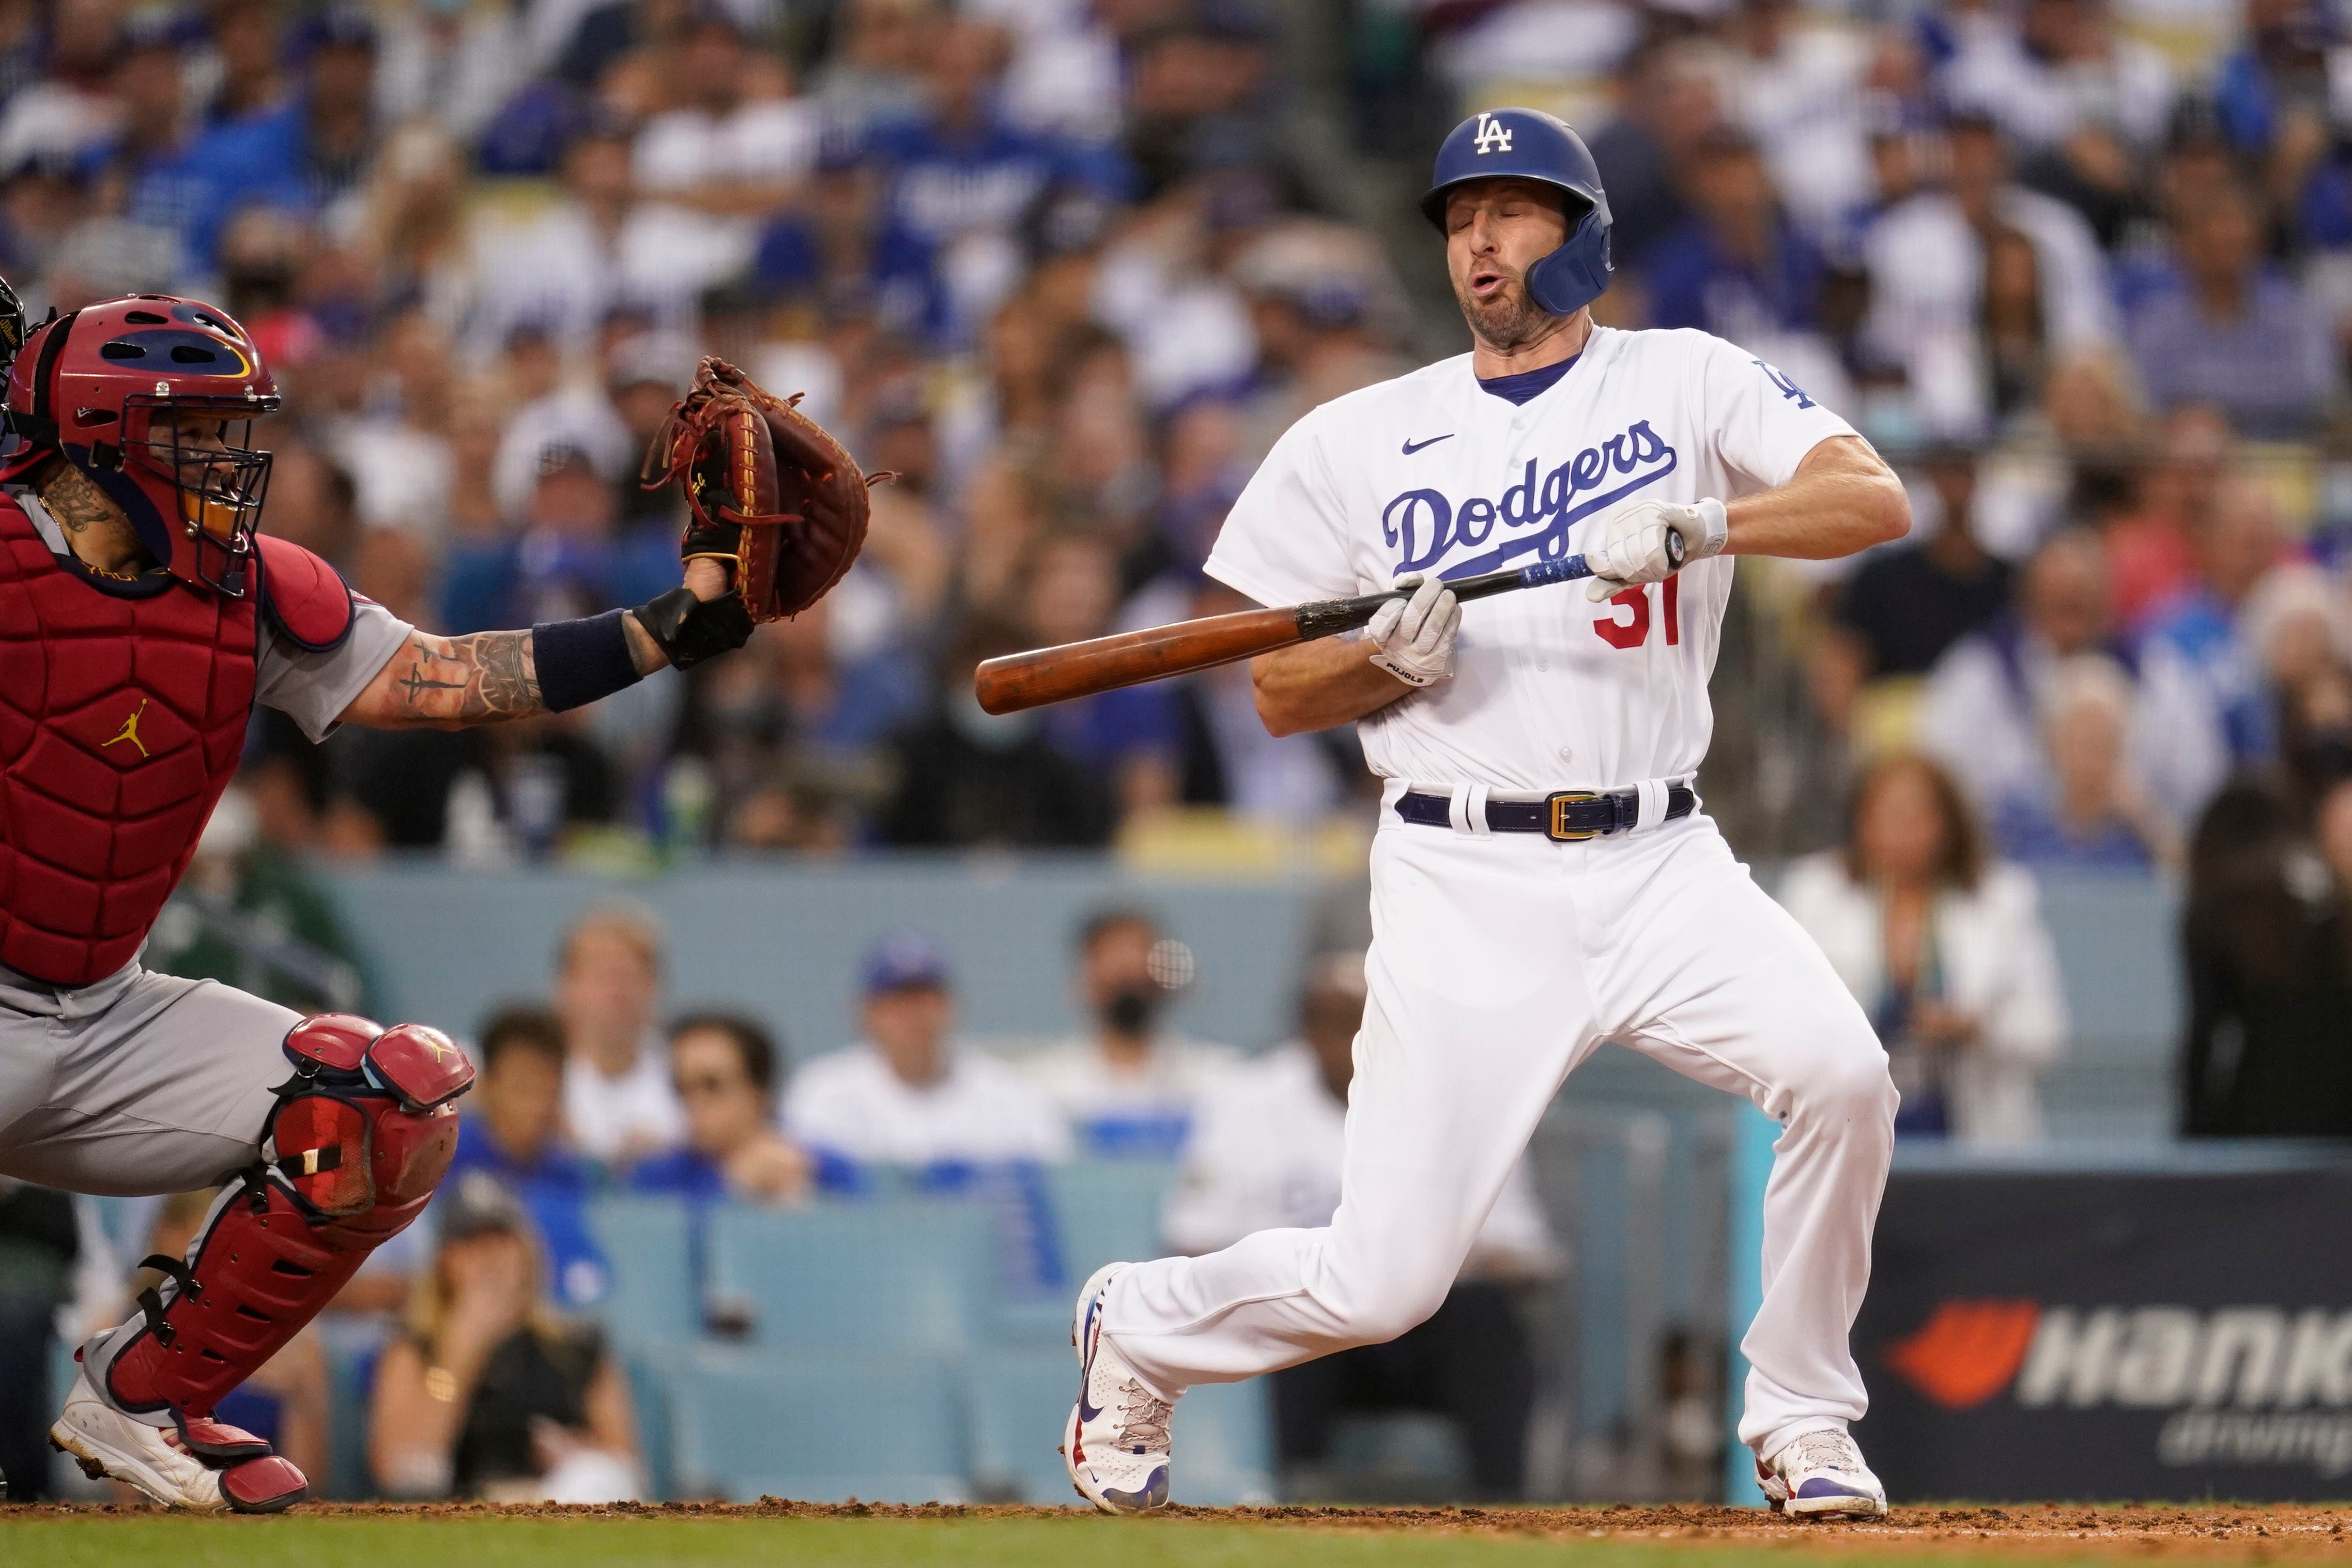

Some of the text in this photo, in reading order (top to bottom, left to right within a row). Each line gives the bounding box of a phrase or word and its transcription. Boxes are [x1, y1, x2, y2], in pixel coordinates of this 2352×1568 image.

[1474, 113, 1512, 154] LA
[1382, 419, 1676, 577] Dodgers
[1593, 573, 1679, 649] 31
[1386, 662, 1424, 683] PUJOLS
